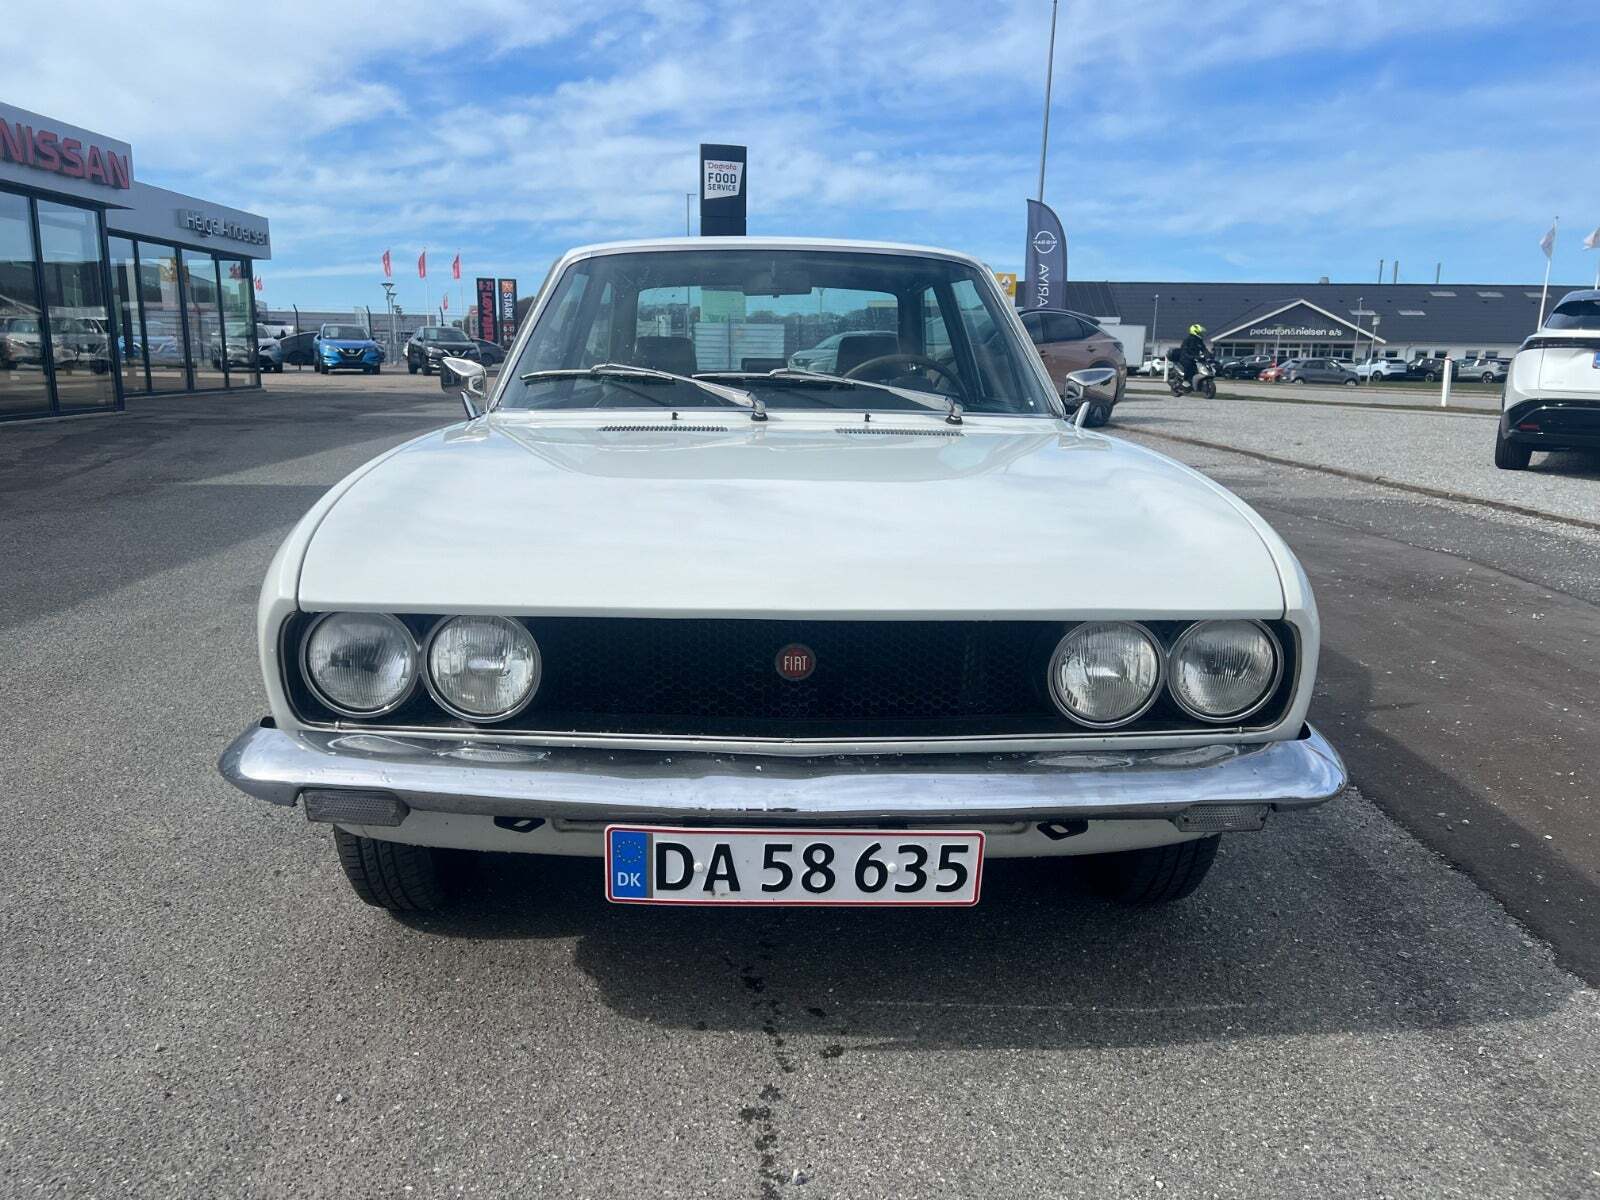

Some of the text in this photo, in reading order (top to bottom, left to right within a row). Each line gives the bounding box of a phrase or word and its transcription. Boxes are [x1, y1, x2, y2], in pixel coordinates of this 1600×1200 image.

[0, 118, 130, 190] NISSAN
[708, 172, 737, 184] FOOD
[707, 183, 736, 191] SERVICE
[503, 292, 513, 321] STARK
[784, 655, 808, 671] FIAT
[655, 841, 969, 893] DA 58 635
[617, 872, 641, 887] DK
